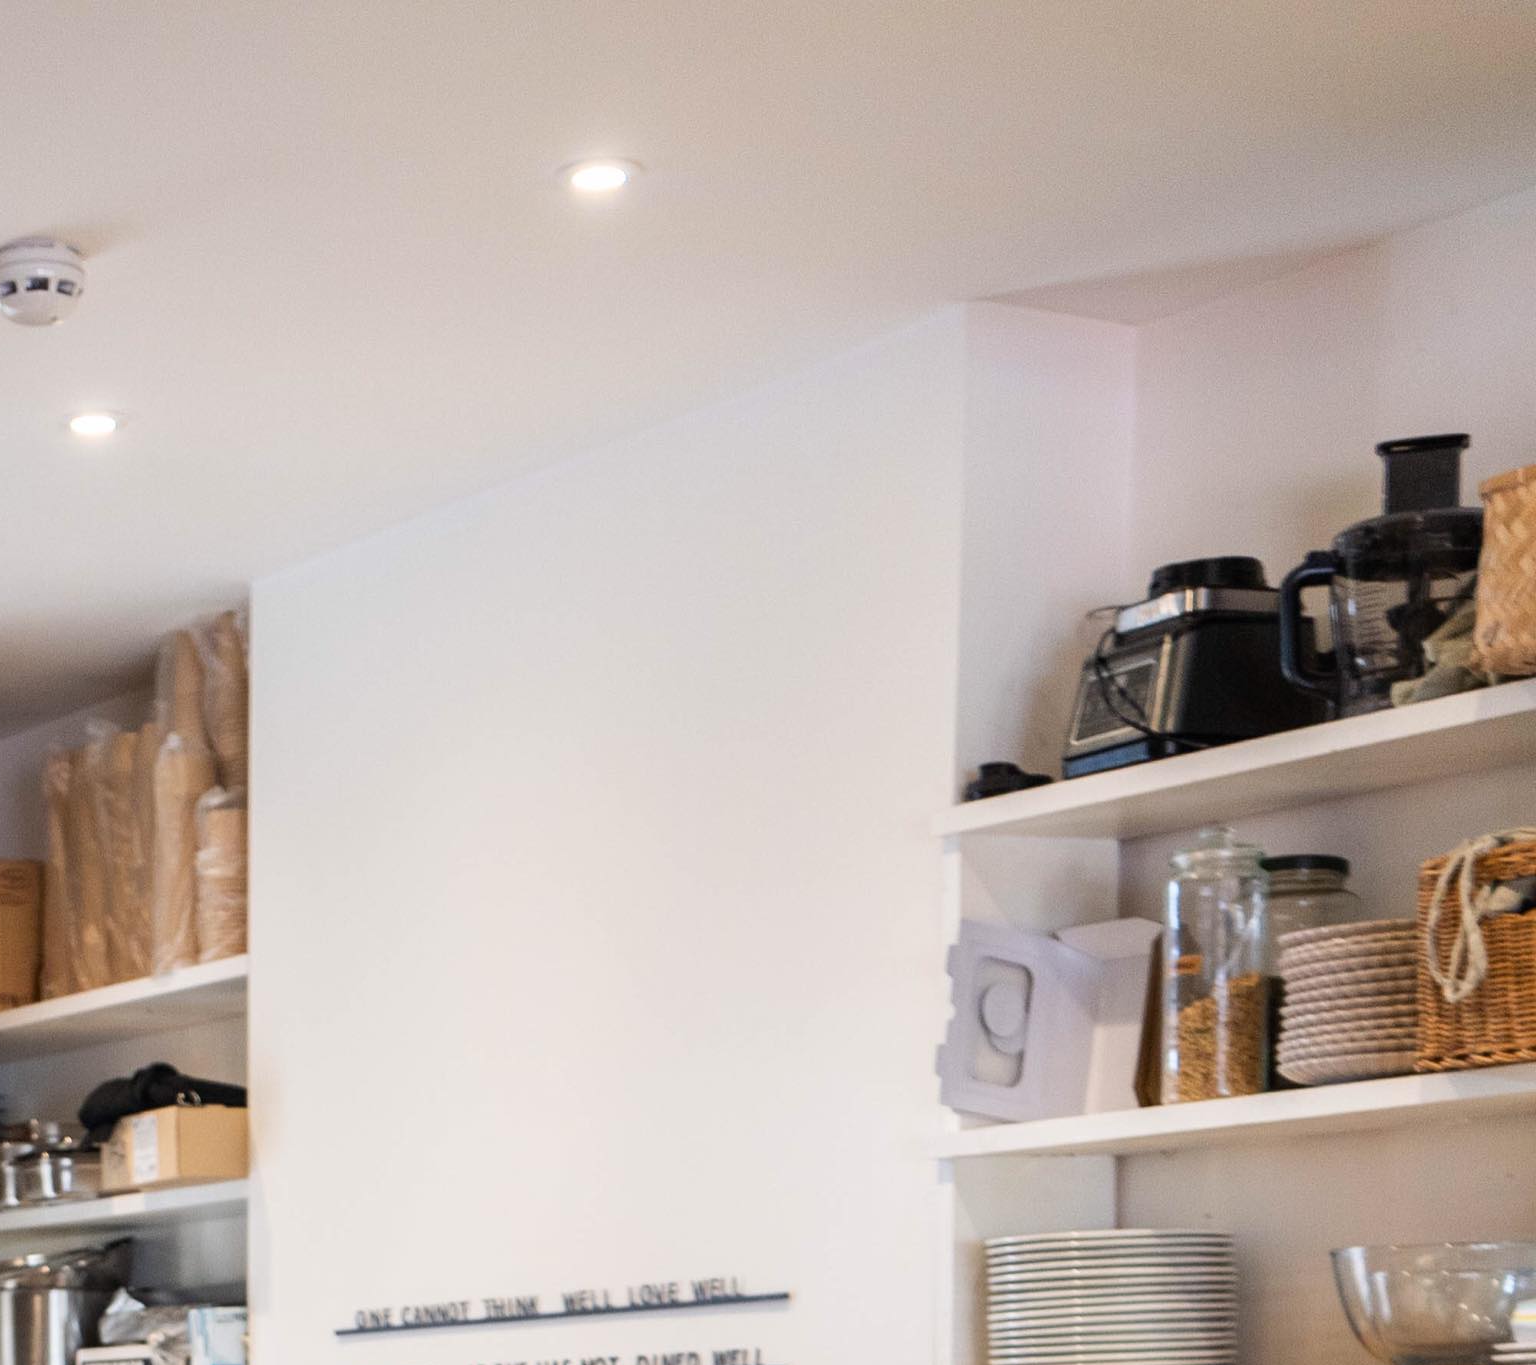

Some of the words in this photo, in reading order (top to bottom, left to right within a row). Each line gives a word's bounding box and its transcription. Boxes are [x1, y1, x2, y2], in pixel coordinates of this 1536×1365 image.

[354, 1308, 392, 1331] ONE
[400, 1299, 470, 1327] CANNOT
[482, 1294, 539, 1321] THINK
[562, 1288, 615, 1314] WELL
[627, 1281, 681, 1308] LOVE
[690, 1276, 745, 1303] WELL
